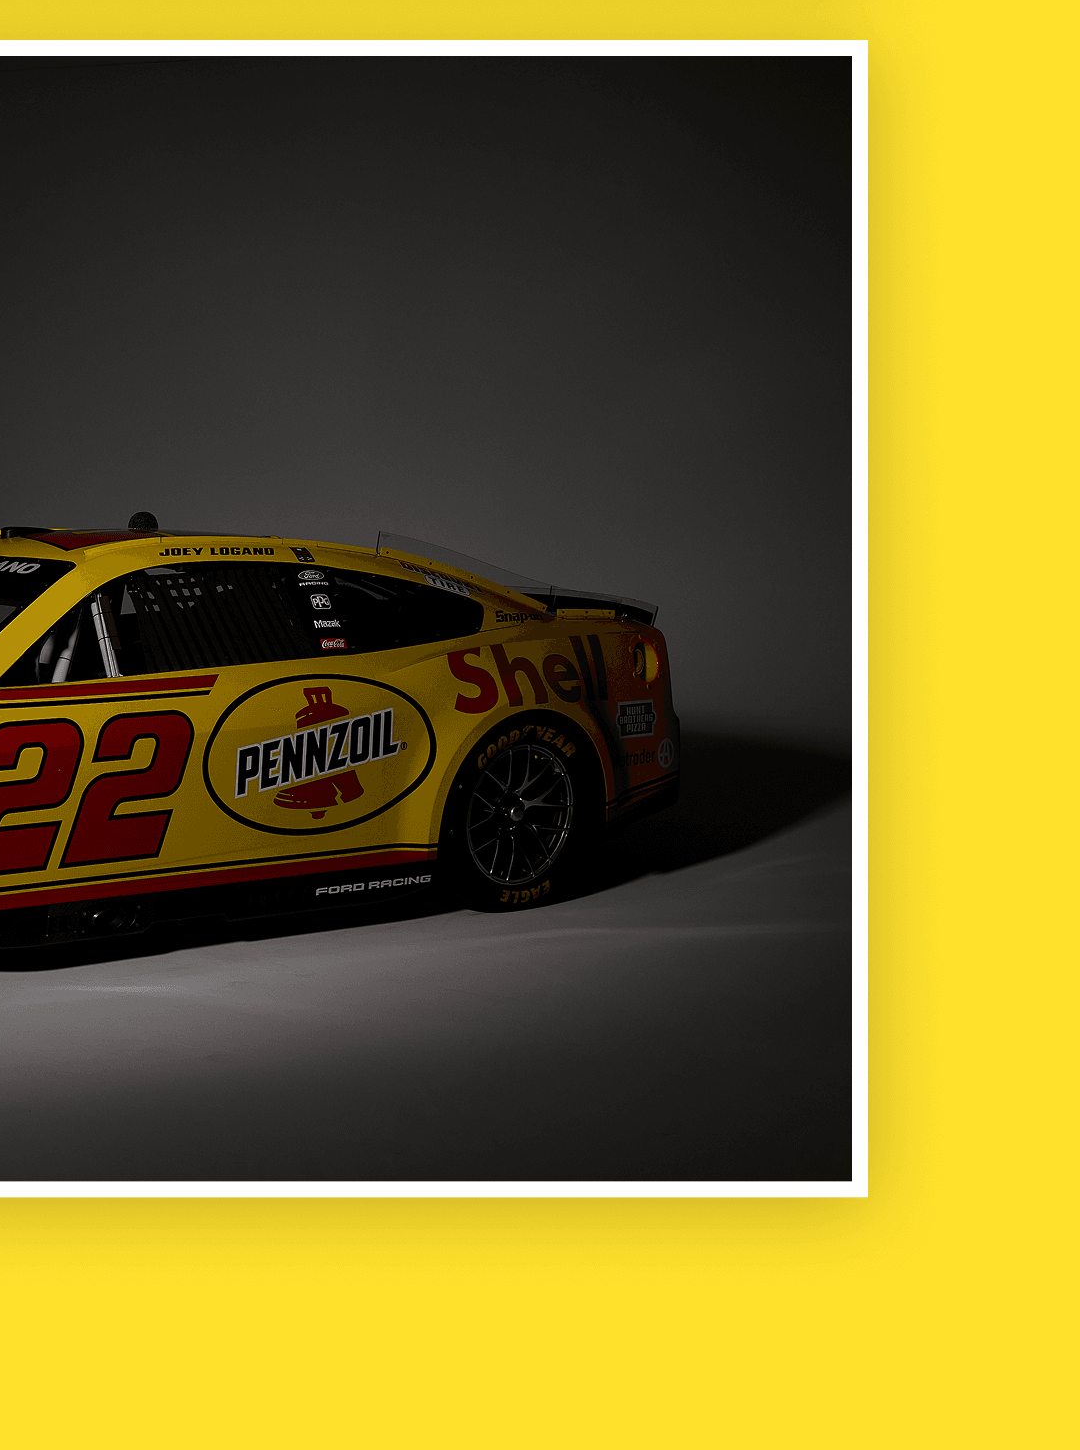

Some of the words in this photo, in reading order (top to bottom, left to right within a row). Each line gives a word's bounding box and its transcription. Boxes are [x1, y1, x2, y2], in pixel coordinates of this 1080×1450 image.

[159, 547, 203, 557] JOEY
[209, 546, 275, 556] LOGANO
[427, 576, 470, 595] TIRE
[311, 594, 331, 608] PPG
[313, 619, 342, 629] Mazak
[447, 634, 609, 715] Shell
[626, 705, 646, 716] HUNT
[619, 714, 654, 725] BROTHERS
[626, 723, 647, 733] PIZZA
[234, 707, 400, 799] PENNZOIL
[477, 724, 577, 771] GOODYEAR
[315, 882, 366, 897] FORD
[367, 874, 432, 892] RACING
[500, 880, 552, 904] EAGLE
